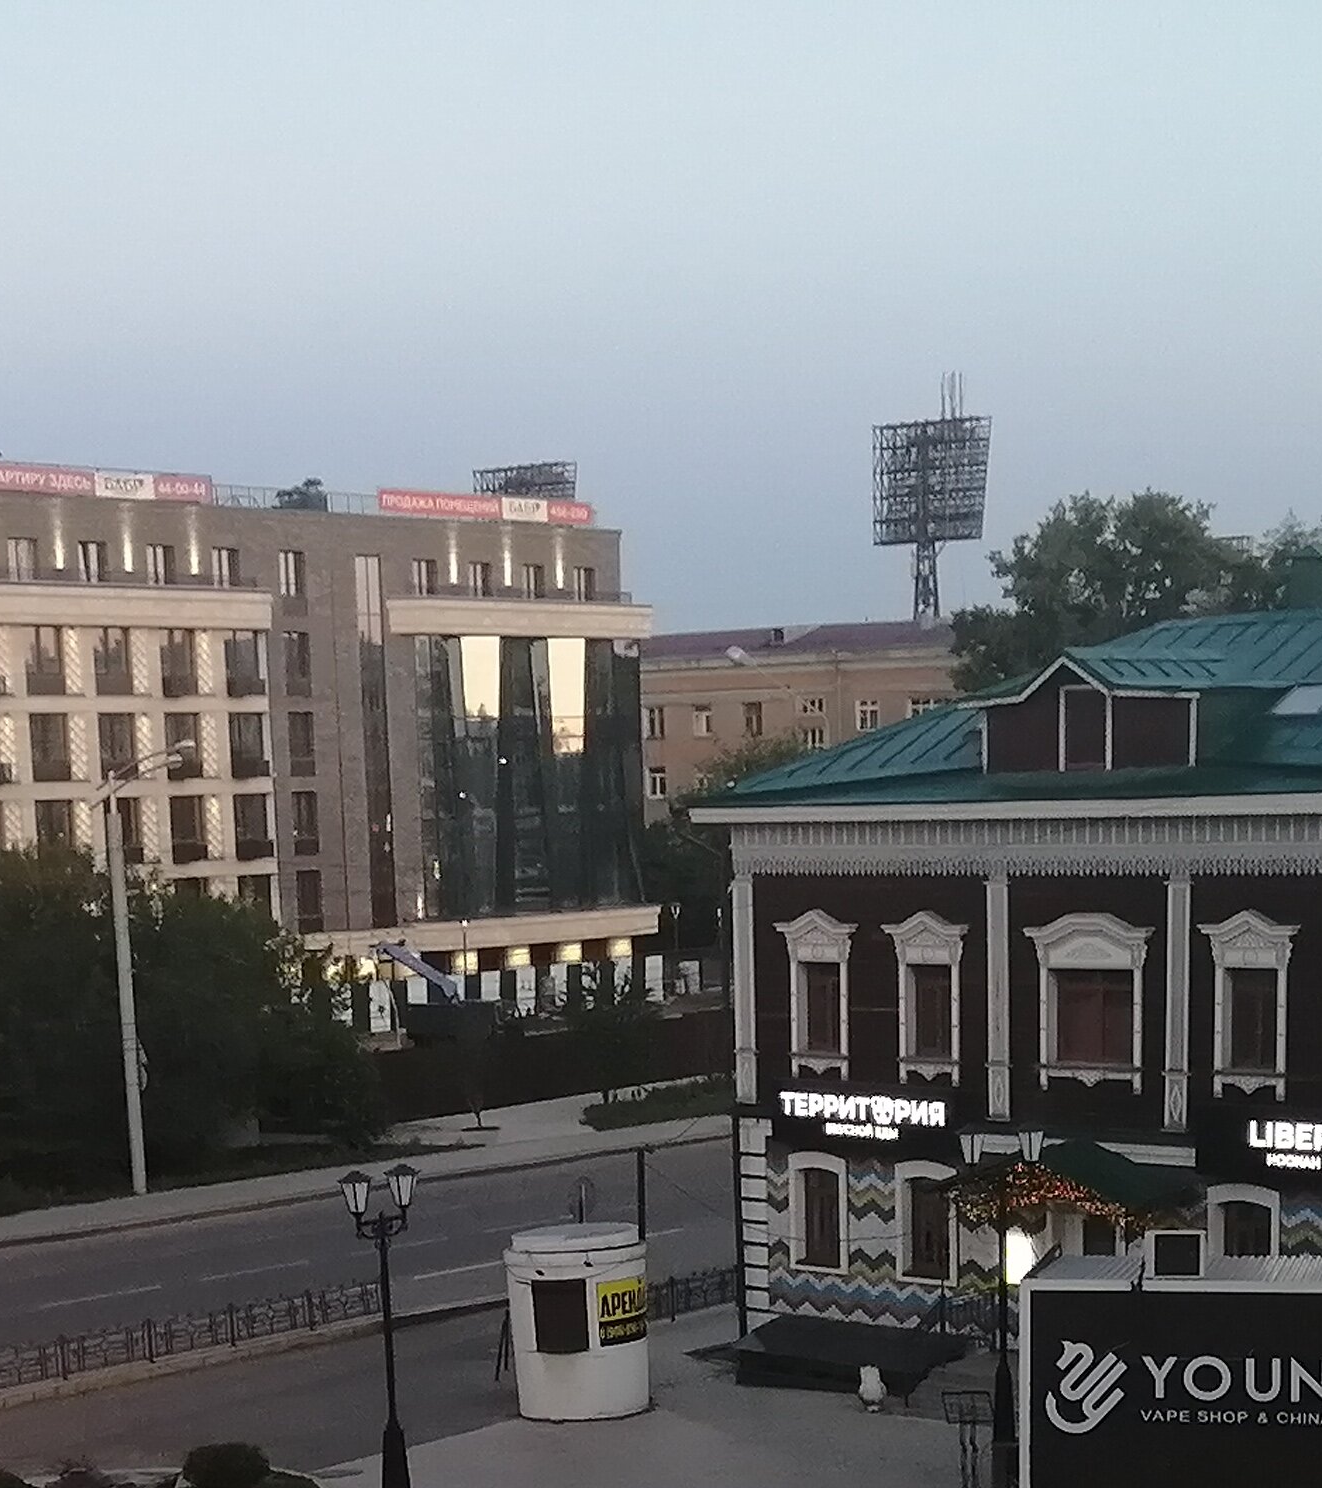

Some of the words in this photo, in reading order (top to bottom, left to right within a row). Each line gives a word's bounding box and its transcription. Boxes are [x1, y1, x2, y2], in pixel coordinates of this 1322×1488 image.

[48, 473, 91, 491] ЗДЕСЬ
[381, 494, 434, 510] ПРОДАЖА
[779, 1091, 946, 1127] ТЕРРИТОРИЯ
[1140, 1409, 1190, 1423] VAPE
[1196, 1409, 1248, 1425] SHOP
[1256, 1412, 1269, 1425] &
